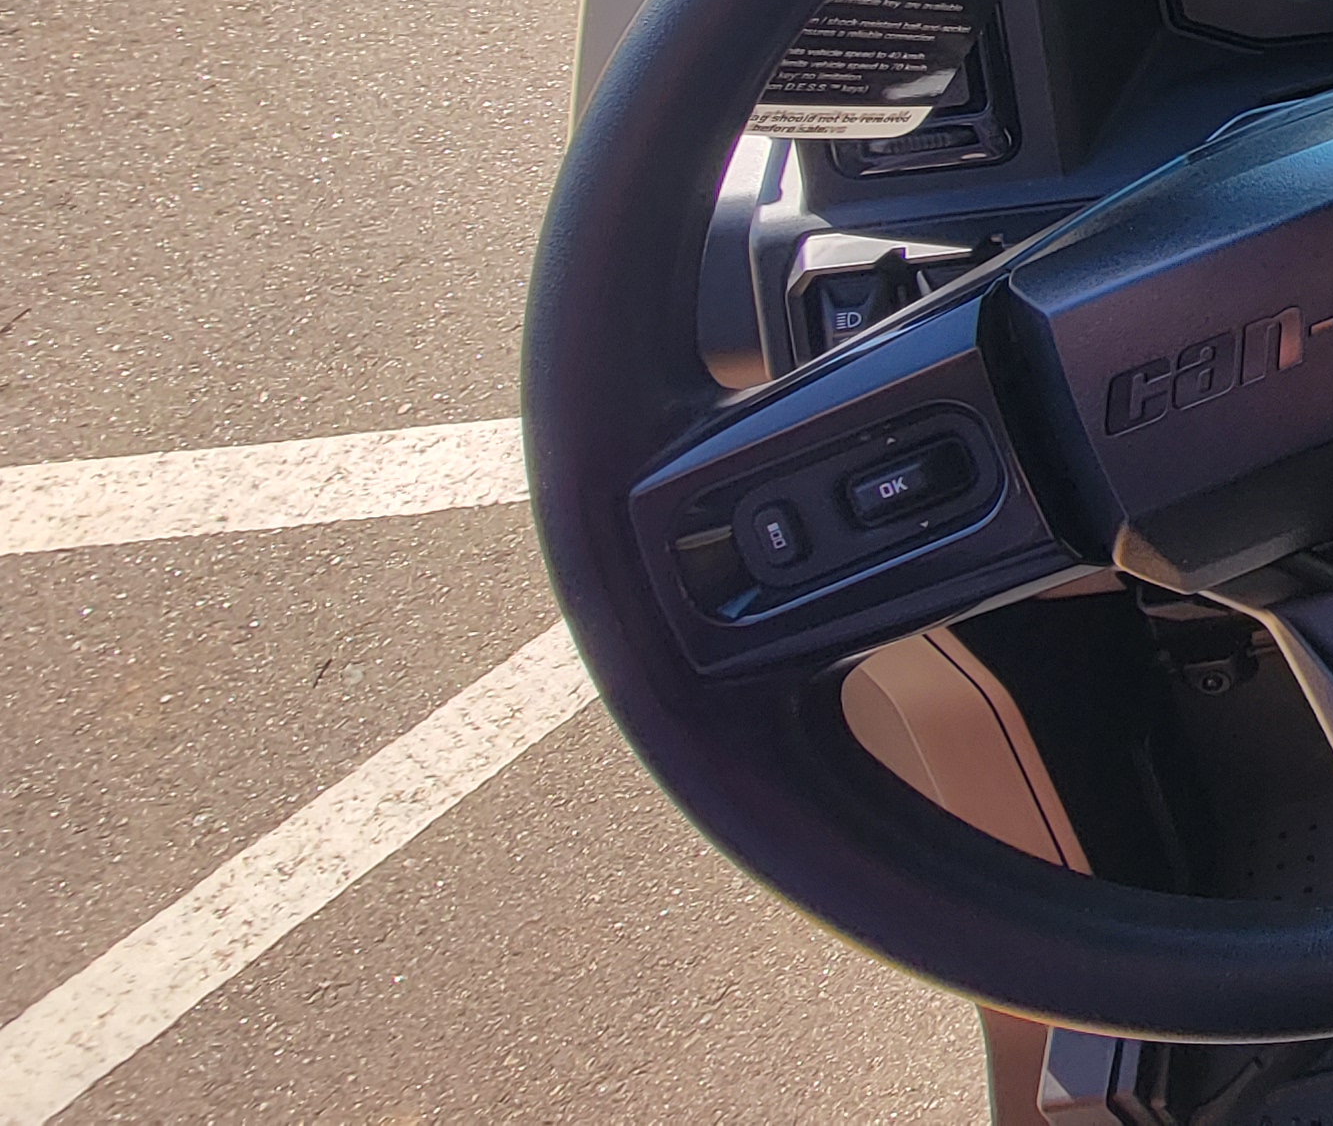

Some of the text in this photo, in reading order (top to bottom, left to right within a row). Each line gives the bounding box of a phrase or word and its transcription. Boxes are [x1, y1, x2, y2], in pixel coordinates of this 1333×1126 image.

[750, 112, 912, 124] ag should not be removed
[752, 124, 797, 133] before
[878, 476, 910, 500] OK
